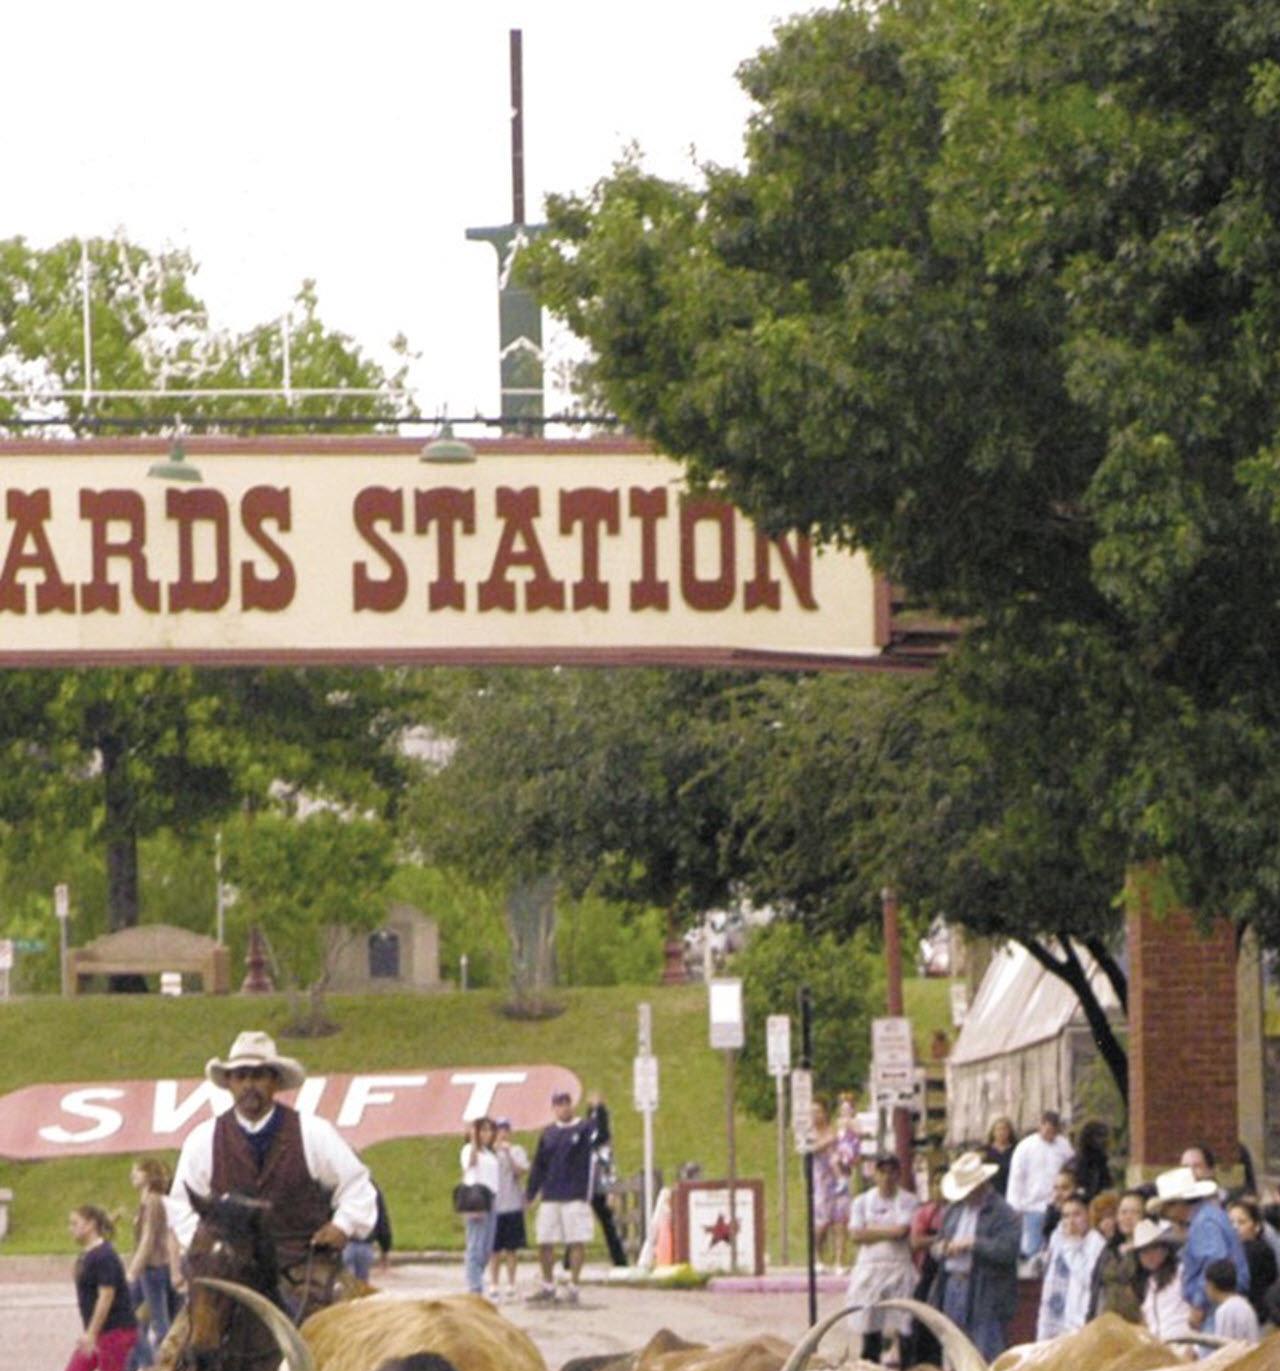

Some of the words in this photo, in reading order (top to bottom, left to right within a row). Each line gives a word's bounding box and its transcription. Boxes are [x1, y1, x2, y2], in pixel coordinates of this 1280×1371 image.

[0, 485, 297, 615] ARDS
[352, 485, 820, 614] STATION
[39, 1072, 527, 1143] SWIFT
